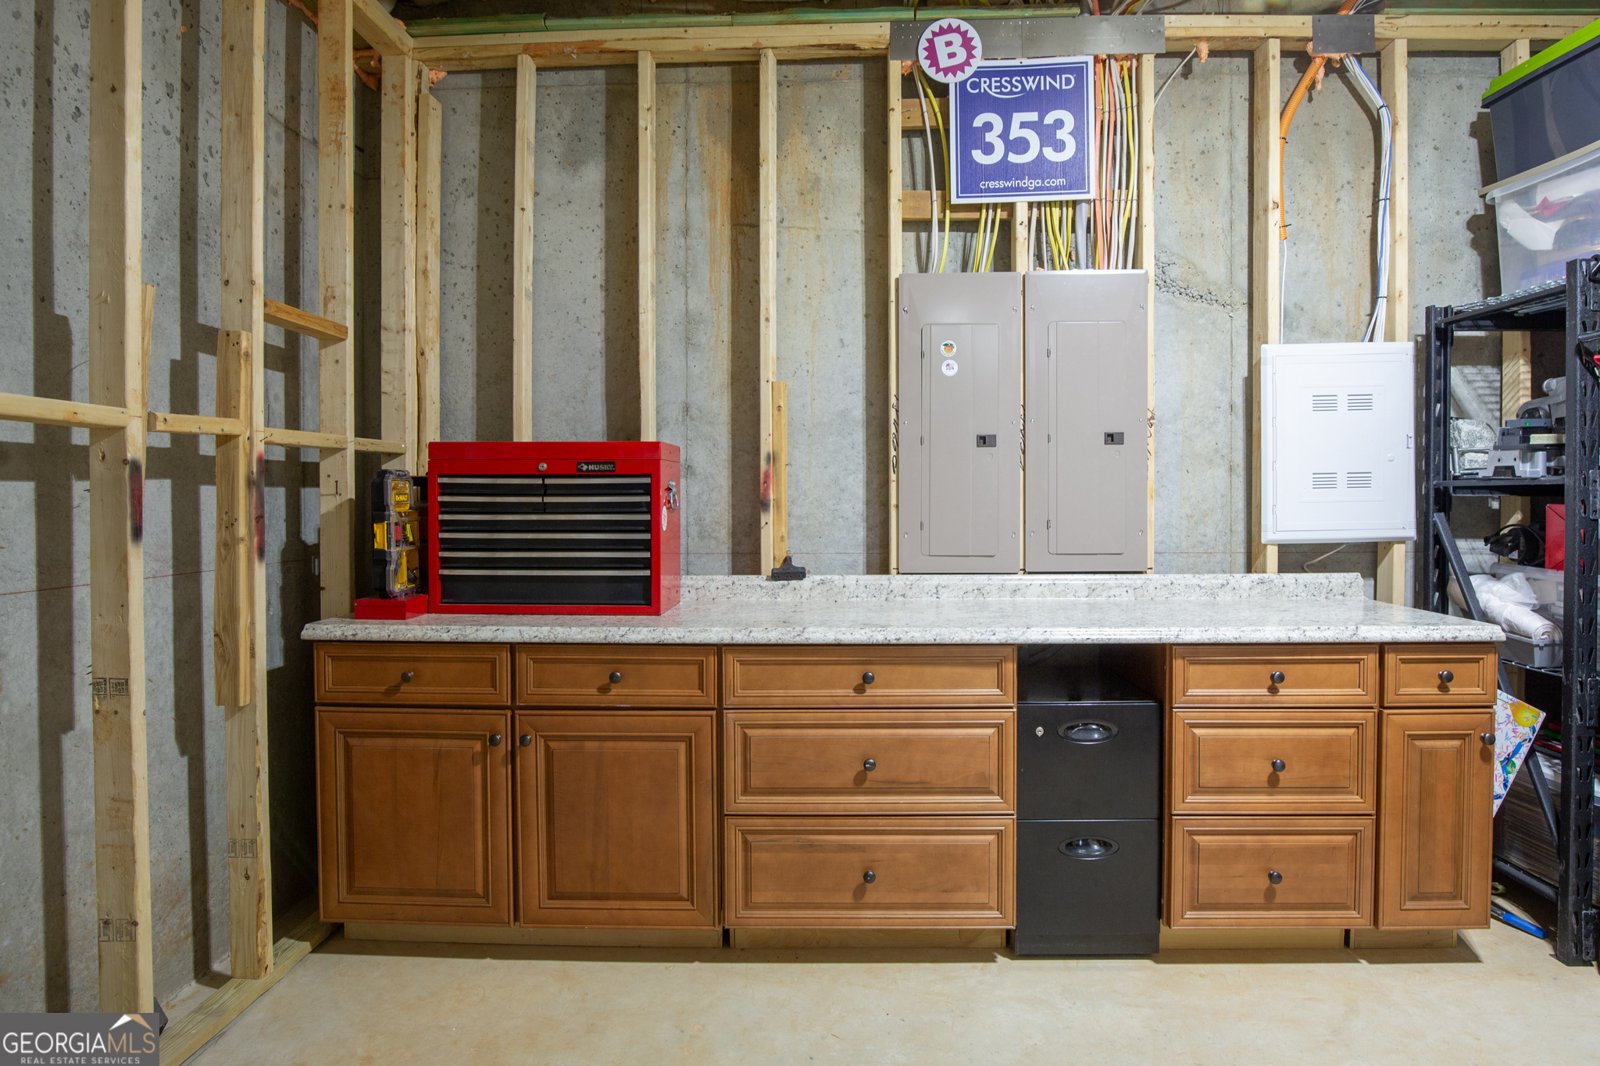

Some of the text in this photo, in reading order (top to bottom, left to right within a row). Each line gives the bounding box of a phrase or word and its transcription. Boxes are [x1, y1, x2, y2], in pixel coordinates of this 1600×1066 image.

[933, 32, 967, 69] B
[966, 74, 1075, 98] CRESSWIND
[971, 109, 1076, 165] 353
[979, 176, 1066, 190] cresswindga.com
